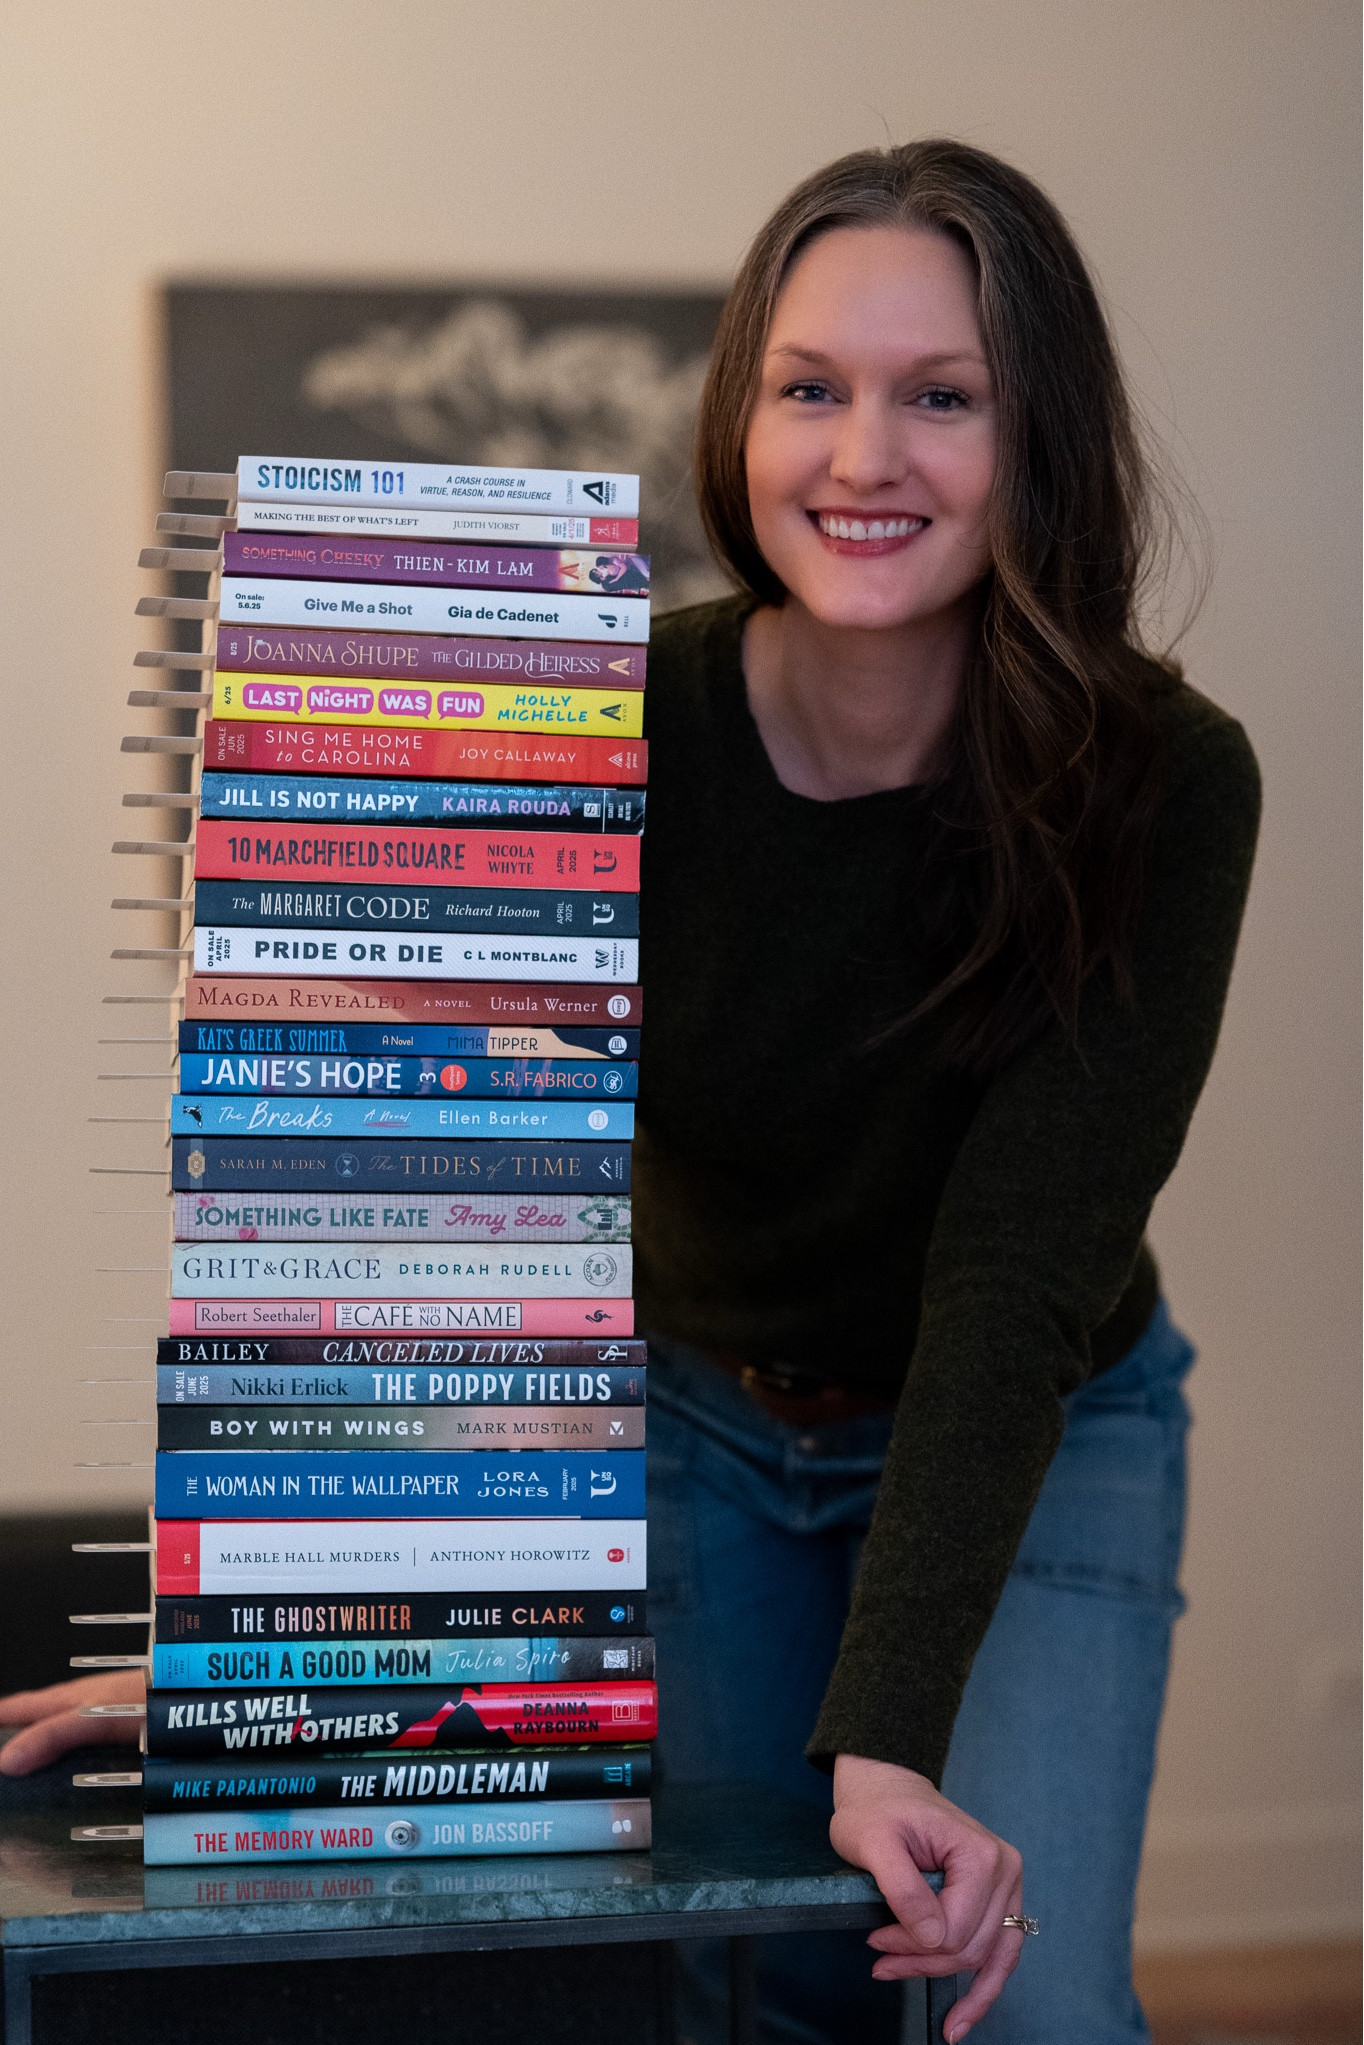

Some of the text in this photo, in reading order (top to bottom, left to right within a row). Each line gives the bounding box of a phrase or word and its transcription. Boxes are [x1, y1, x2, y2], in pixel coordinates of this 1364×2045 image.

[257, 464, 405, 495] STOICISM 101
[446, 475, 526, 488] A CRASH COURSE IN
[419, 485, 552, 501] VIRTUE, REASON, AND RESILIENCE
[254, 511, 419, 527] MAKING THE BEST OF WHAT'S LEFT
[453, 520, 520, 532] JUDITH VIORST
[235, 592, 265, 602] On sale:
[238, 601, 261, 611] 5.6.25
[304, 598, 413, 616] Give Me a Shot
[447, 605, 559, 623] Gia de Cadenet
[230, 642, 238, 656] 8/25
[243, 635, 419, 668] JOANNA SHUPE
[224, 686, 232, 705] 6/25
[248, 689, 299, 707] LAST
[383, 695, 427, 712] WAS
[442, 696, 481, 714] FUN
[515, 693, 572, 708] HOLLY
[498, 708, 588, 724] MICHELLE
[217, 726, 227, 761] ON SALE
[227, 736, 236, 753] JUN
[236, 734, 245, 755] 2025
[265, 729, 423, 750] SING ME HOME
[276, 749, 412, 767] to CAROLINA
[459, 747, 576, 764] JOY CALLAWAY
[219, 788, 418, 813] JILL IS NOT HAPPY
[442, 796, 571, 816] KAIRA ROUDA
[227, 837, 466, 872] 10 MARCHFIELD SQUARE
[486, 844, 535, 859] NICOLA
[557, 847, 565, 875] APRIL
[489, 860, 534, 876] WHYTE
[569, 850, 577, 873] 2025
[232, 892, 430, 921] The MARGARET CODE
[445, 904, 540, 918] Richard Hooton
[565, 904, 573, 922] 2025
[207, 930, 215, 967] ON SALE
[255, 940, 443, 963] PRIDE OR DIE
[490, 996, 598, 1013] Ursula Werner
[321, 1060, 401, 1090] HOPE
[438, 1109, 548, 1126] Ellen Barker
[220, 1159, 326, 1171] SARAH M. EDEN
[195, 1207, 429, 1228] SOMETHING LIKE FATE
[399, 1263, 572, 1276] DEBORAH RUDELL
[201, 1308, 316, 1323] Robert Seethaler
[178, 1343, 269, 1361] BAILEY
[323, 1341, 545, 1364] CANCELED LIVES
[175, 1371, 185, 1402] ON SALE
[187, 1376, 197, 1396] JUNE
[199, 1375, 209, 1395] 2025
[231, 1377, 348, 1397] Nikki Erlick
[371, 1373, 416, 1400] THE
[429, 1373, 514, 1400] POPPY
[526, 1373, 611, 1400] FIELDS
[210, 1420, 425, 1436] BOY WITH WINGS
[457, 1422, 594, 1434] MARK MUSTIAN
[206, 1475, 460, 1497] WOMAN IN THE WALLPAPER
[483, 1471, 540, 1483] LORA
[477, 1485, 549, 1498] JONES
[219, 1551, 400, 1564] MARBLE HALL MURDERS
[430, 1549, 591, 1562] ANTHONY HOROWITZ
[231, 1605, 412, 1634] THE GHOSTWRITER
[446, 1606, 585, 1626] JULIE CLARK
[207, 1651, 271, 1681] SUCH
[279, 1651, 294, 1679] A
[302, 1649, 367, 1679] GOOD
[375, 1648, 431, 1677] MOM
[168, 1694, 312, 1729] KILLS WELL
[523, 1700, 589, 1718] DEANNA
[223, 1711, 400, 1750] WITH OTHERS
[514, 1718, 599, 1735] RAYBOURN
[172, 1776, 316, 1798] MIKE PAPANTONIO
[341, 1761, 550, 1798] THE MIDDLEMAN
[194, 1827, 373, 1853] THE MEMORY WARD
[433, 1820, 554, 1845] JON BASSOFF
